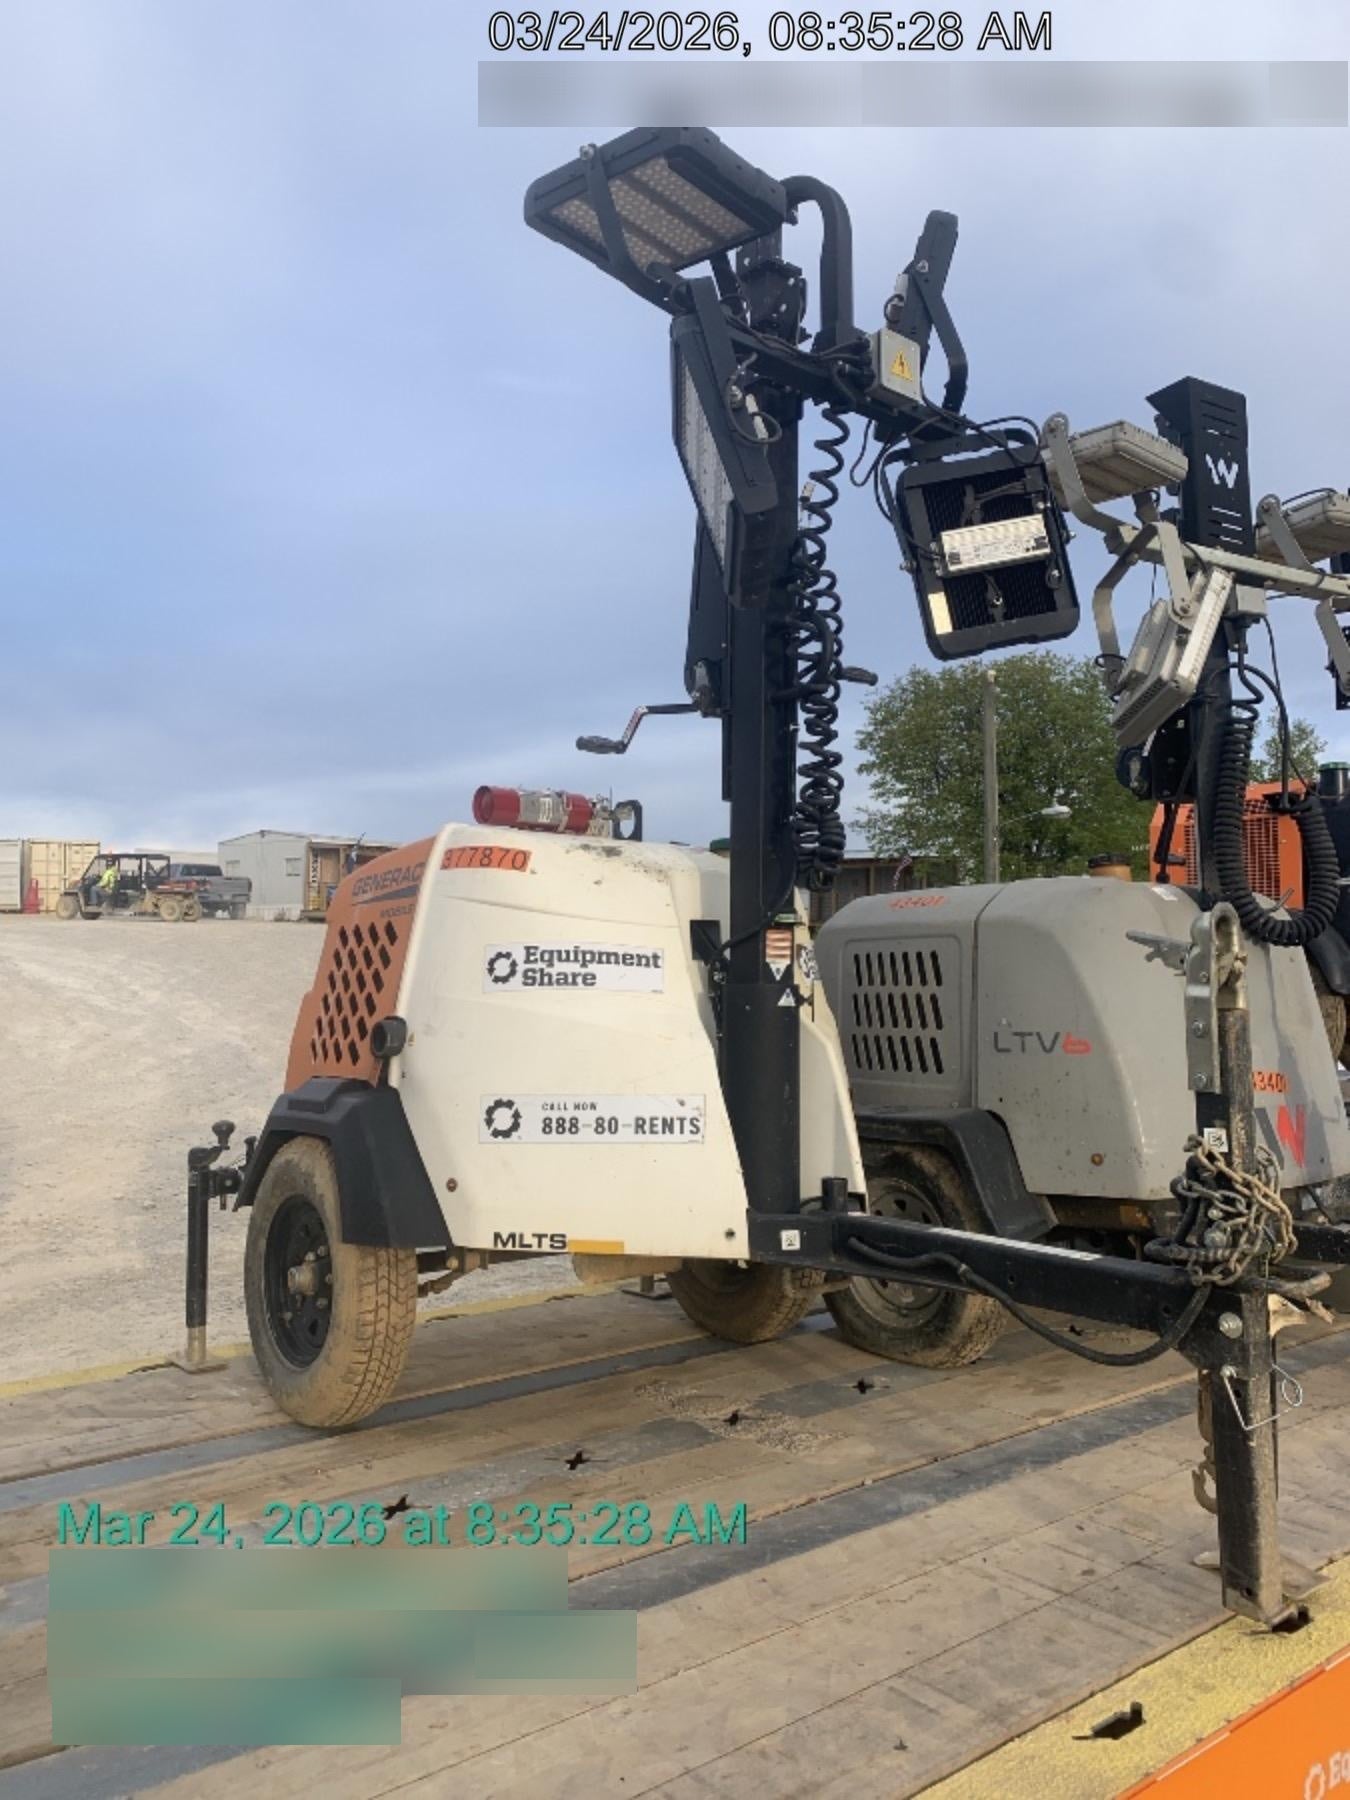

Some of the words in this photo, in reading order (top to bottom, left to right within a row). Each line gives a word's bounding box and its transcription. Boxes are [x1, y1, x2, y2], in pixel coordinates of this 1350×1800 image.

[523, 945, 662, 969] Equipment
[521, 967, 597, 987] Share
[541, 1102, 569, 1112] CALL
[541, 1116, 701, 1136] 888-80-RENTS
[493, 1231, 567, 1250] MLTS
